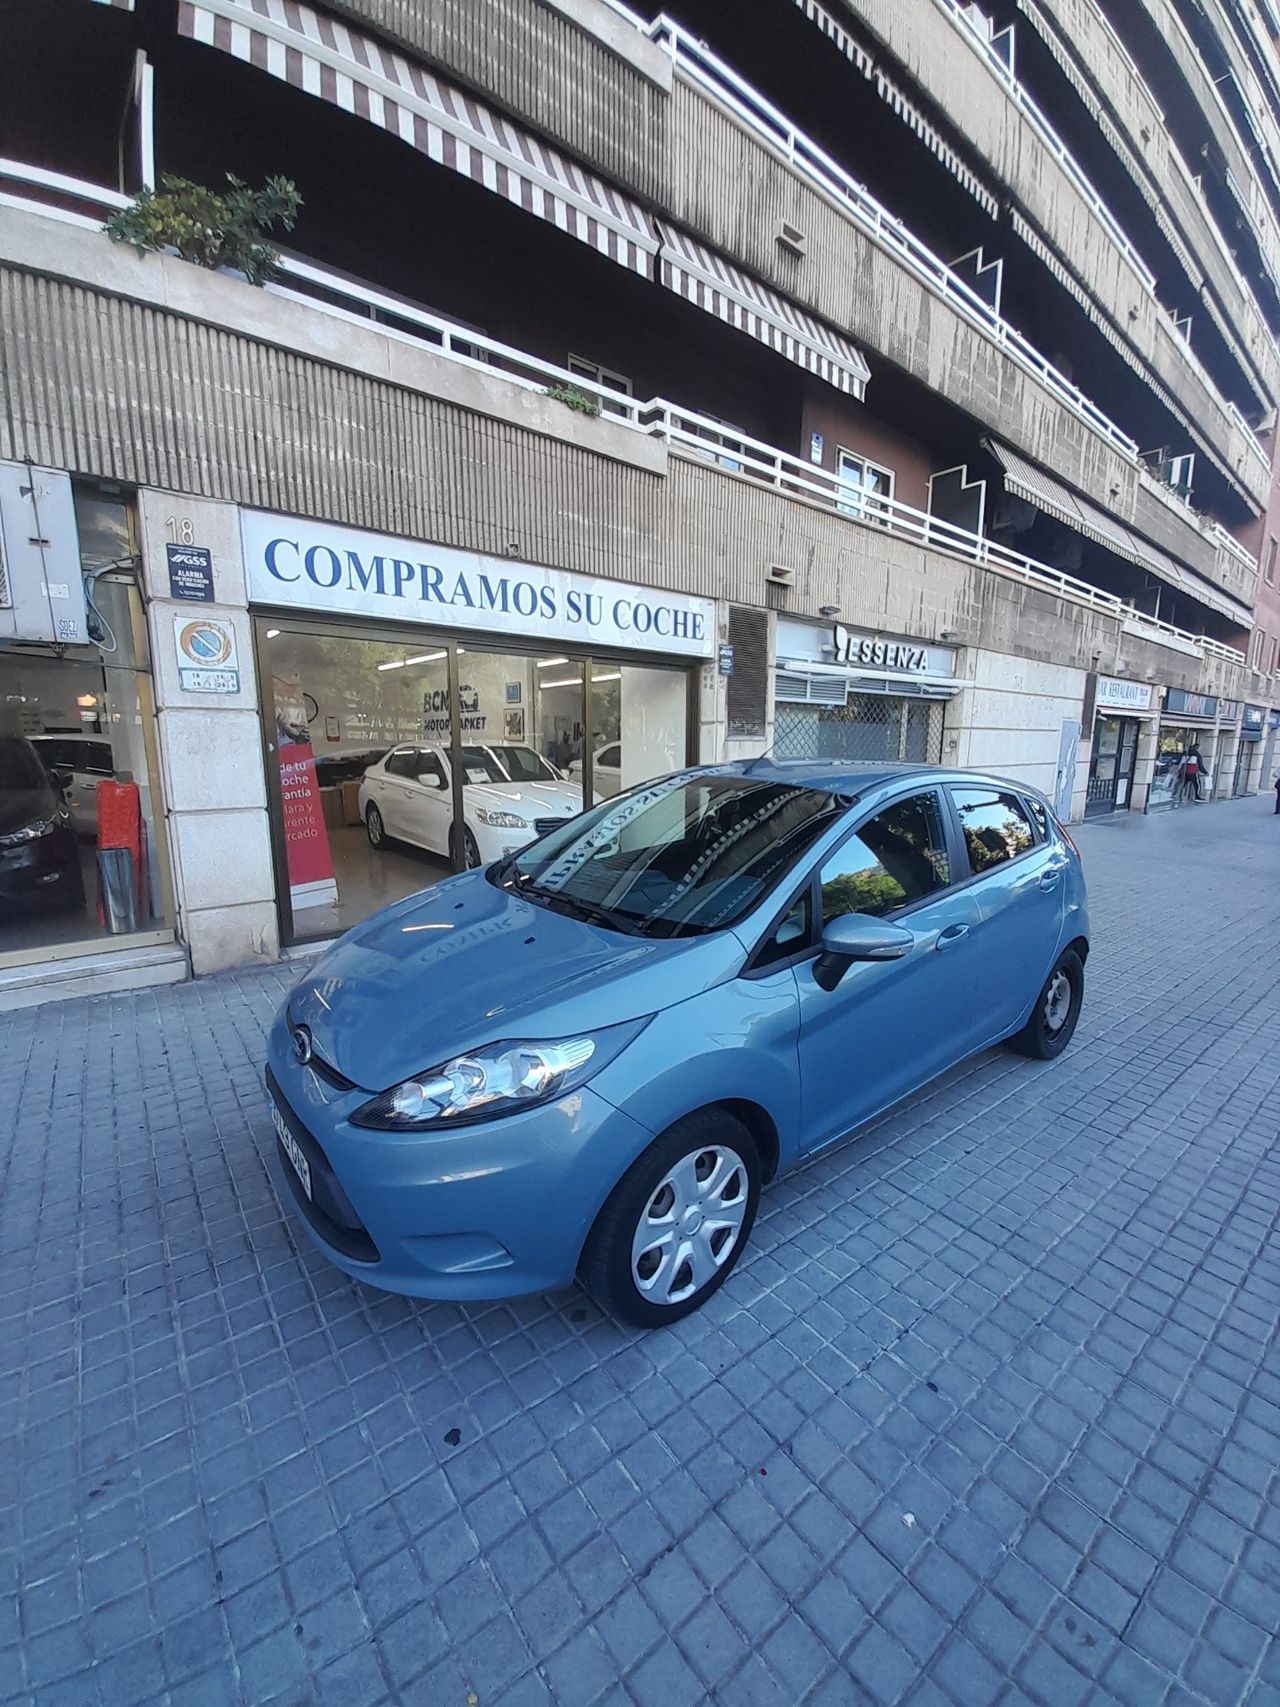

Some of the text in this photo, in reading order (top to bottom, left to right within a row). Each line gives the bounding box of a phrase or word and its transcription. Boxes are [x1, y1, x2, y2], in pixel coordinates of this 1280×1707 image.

[166, 515, 194, 546] 18
[177, 569, 204, 579] ALARMA
[264, 538, 705, 641] COMPRAMOS SU COCHE
[848, 637, 929, 671] ESSENZA
[459, 716, 487, 730] ARKET
[295, 761, 307, 771] tu
[282, 774, 309, 786] oche
[285, 803, 314, 815] lara y
[287, 829, 319, 842] rcado
